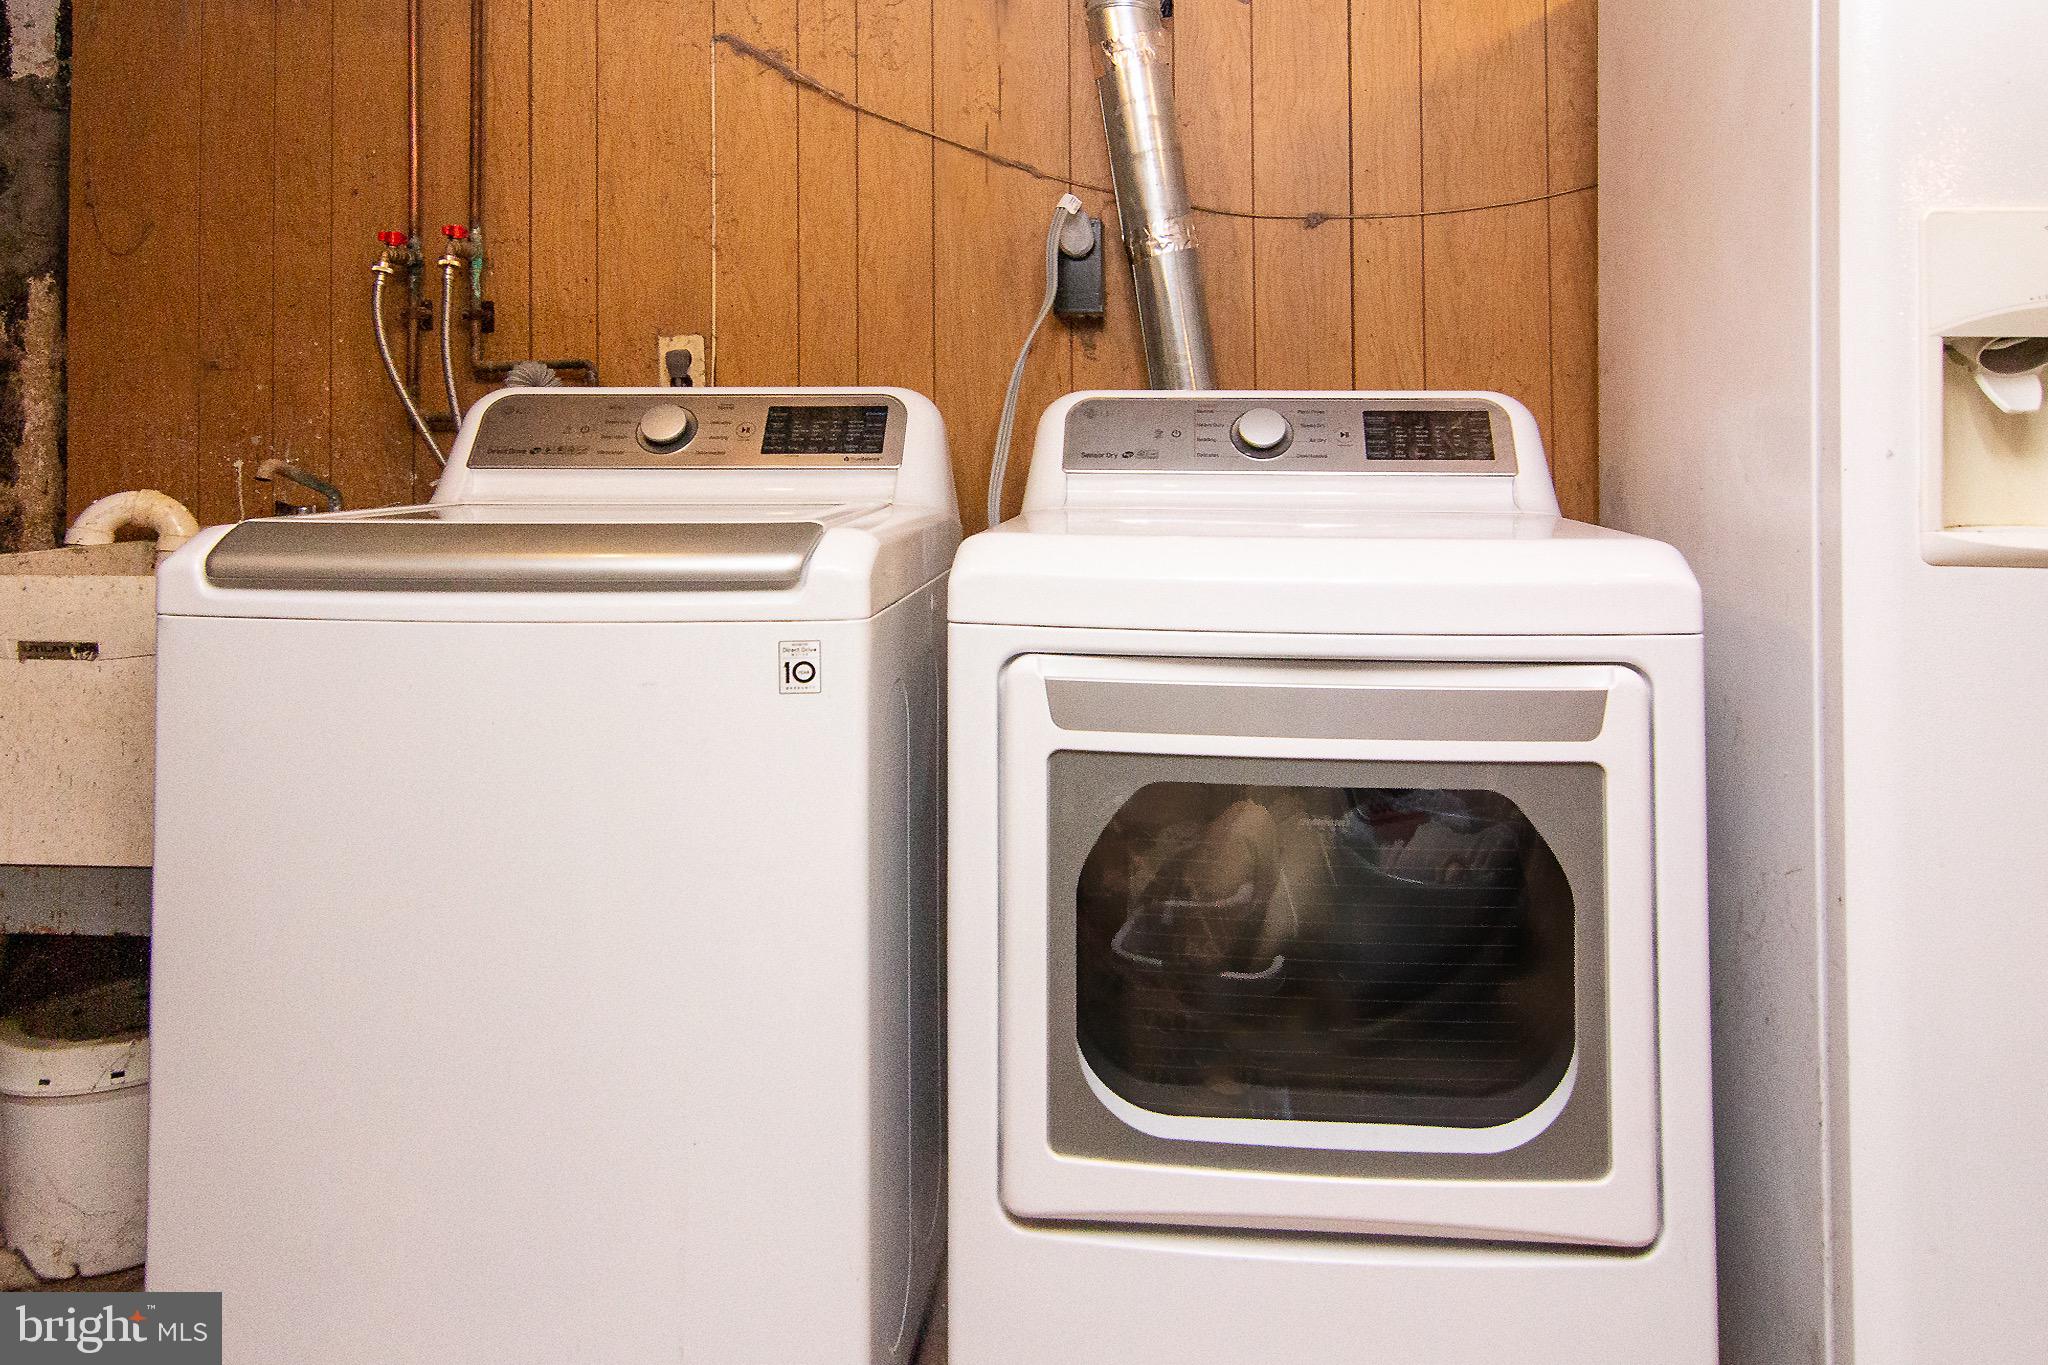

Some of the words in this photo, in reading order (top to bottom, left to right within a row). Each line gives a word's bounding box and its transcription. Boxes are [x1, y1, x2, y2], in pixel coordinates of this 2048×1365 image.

[1081, 451, 1105, 459] Sensor
[1106, 451, 1118, 460] Dry
[784, 661, 816, 683] 10
